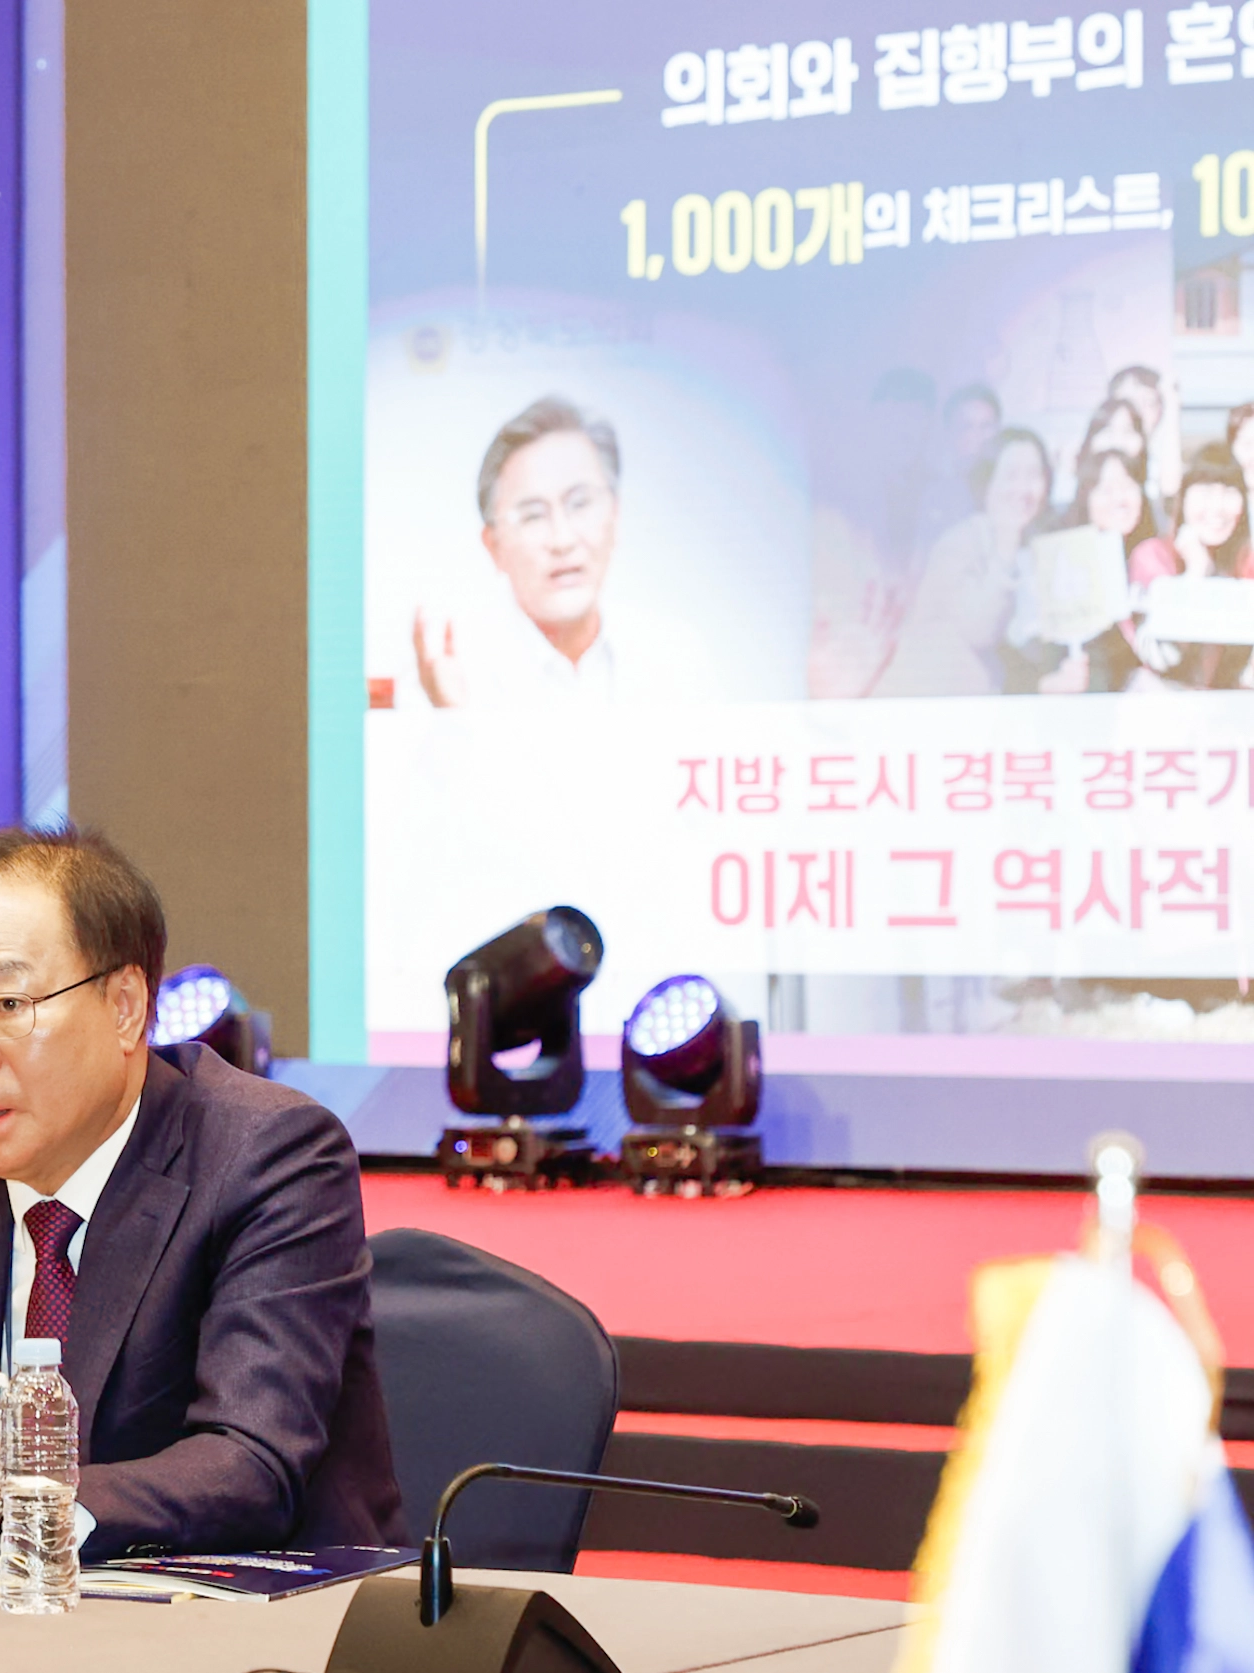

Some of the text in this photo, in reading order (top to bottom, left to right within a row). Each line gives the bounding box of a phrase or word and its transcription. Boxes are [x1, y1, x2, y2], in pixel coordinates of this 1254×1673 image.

[661, 37, 859, 128] 의회와
[874, 8, 1145, 111] 집행부의
[677, 754, 786, 815] 지방
[807, 753, 917, 813] 도시
[943, 750, 1055, 812] 경북
[709, 847, 1231, 932] 이제 그 역사적
